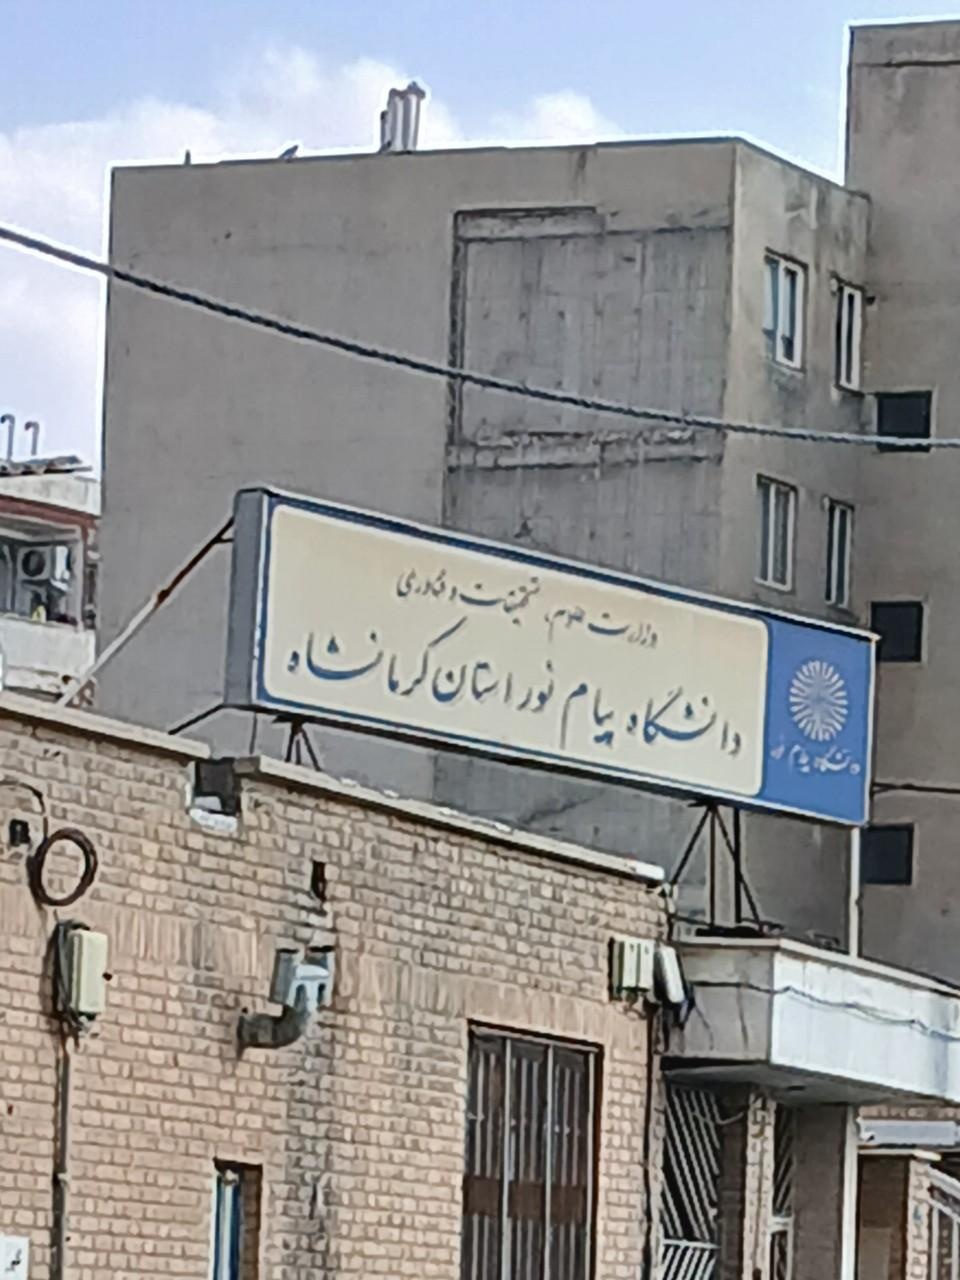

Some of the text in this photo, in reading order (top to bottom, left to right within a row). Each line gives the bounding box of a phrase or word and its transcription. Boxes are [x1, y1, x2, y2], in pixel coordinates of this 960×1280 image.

[587, 611, 658, 649] وزارت
[286, 615, 742, 756] دانشگاه پیام نور استان کرمانشاه
